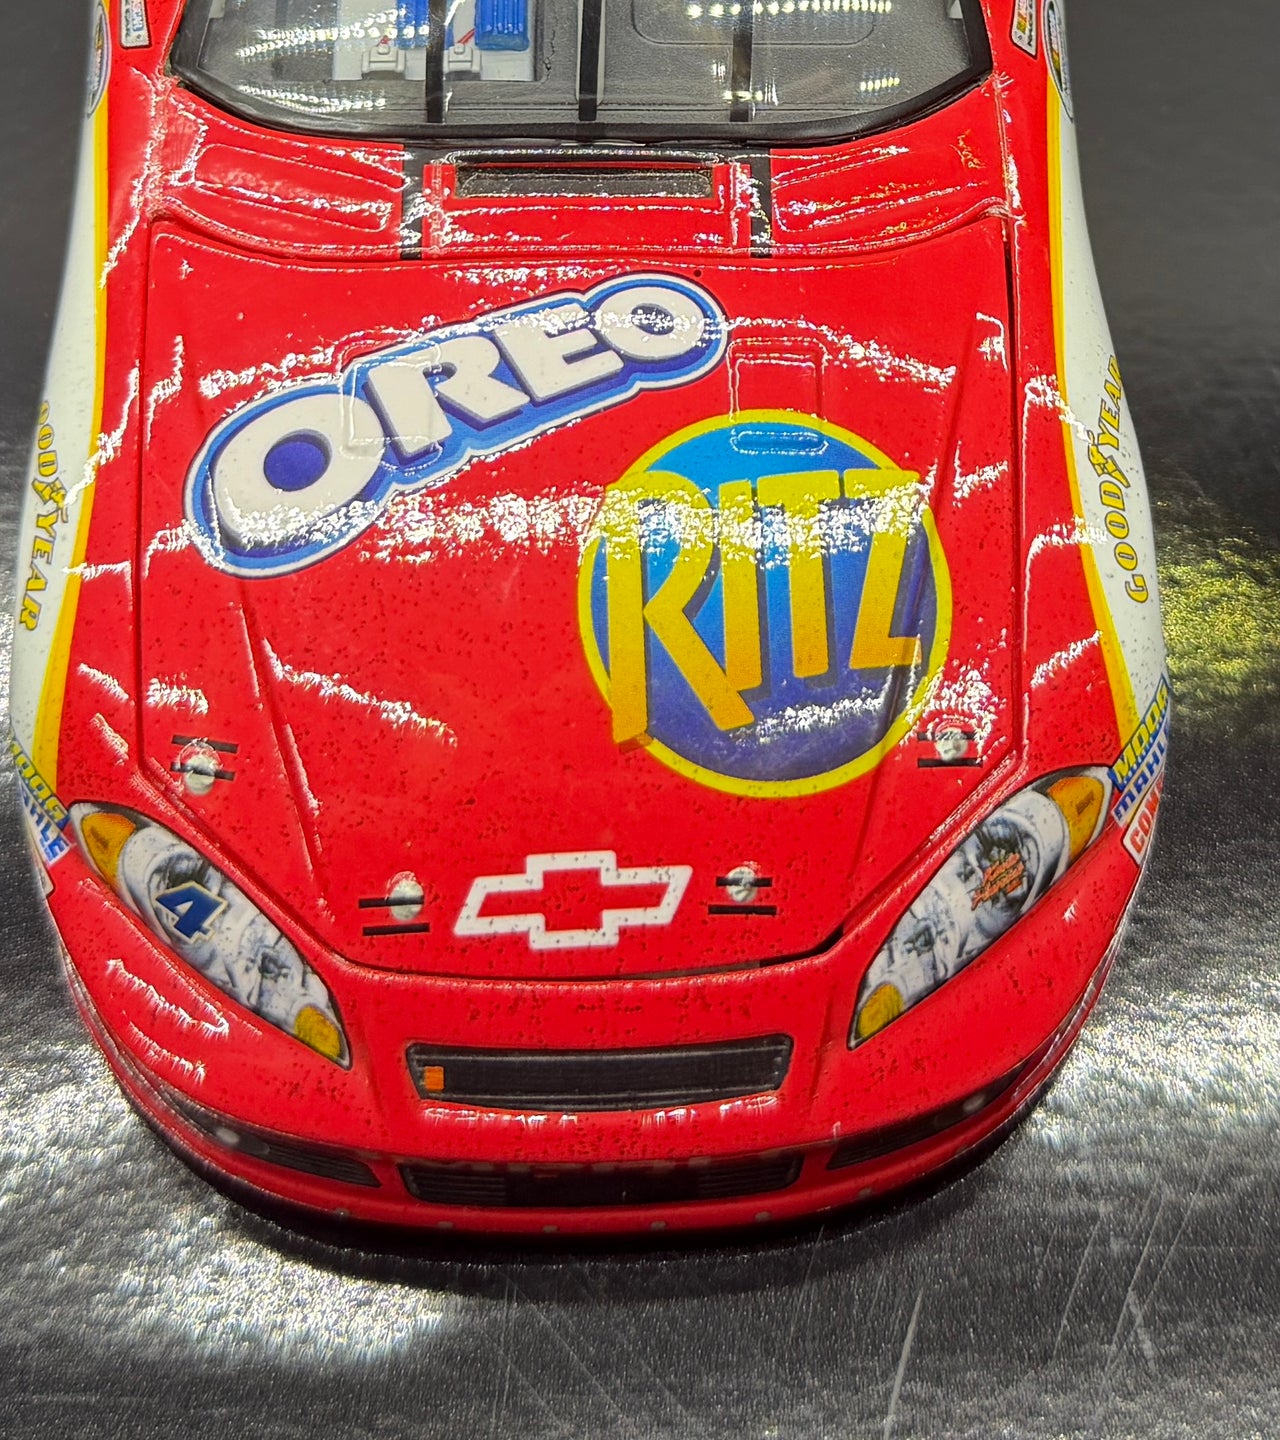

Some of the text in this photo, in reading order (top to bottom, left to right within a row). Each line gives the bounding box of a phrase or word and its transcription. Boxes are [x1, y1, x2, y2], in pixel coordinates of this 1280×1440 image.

[212, 285, 706, 548] OREO
[20, 400, 61, 631] OODYEAR
[605, 469, 922, 745] RITZ
[10, 740, 69, 823] OOG
[1114, 723, 1168, 819] MAHL
[154, 882, 227, 944] 4
